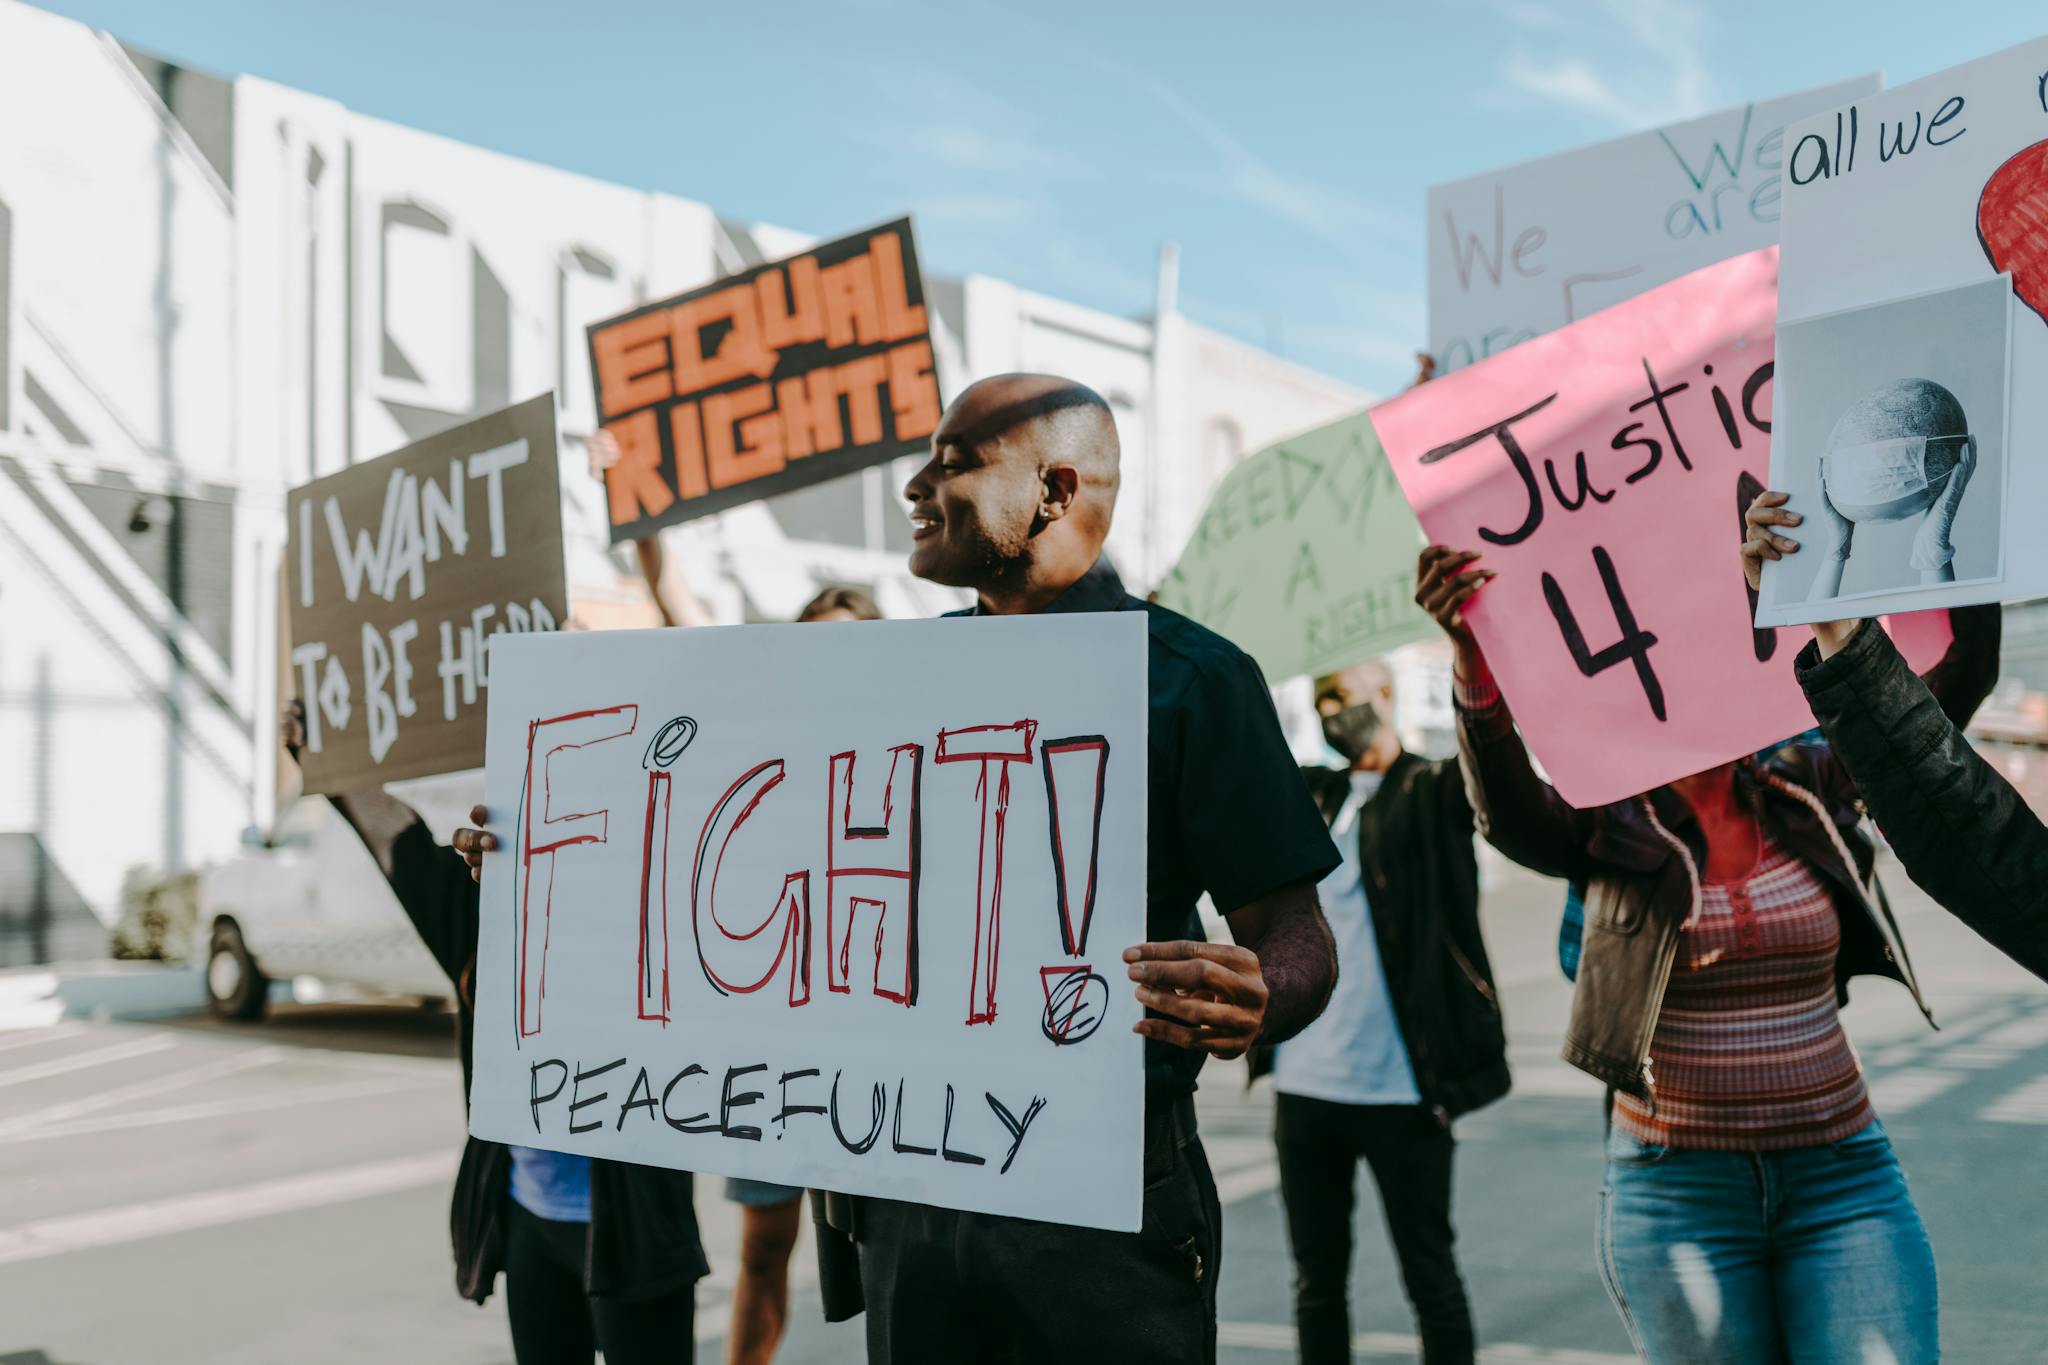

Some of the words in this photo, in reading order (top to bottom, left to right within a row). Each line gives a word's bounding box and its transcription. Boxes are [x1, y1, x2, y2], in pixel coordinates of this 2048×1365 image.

[1657, 101, 1785, 191] We
[1663, 173, 1783, 241] are
[1789, 105, 1858, 186] all
[1878, 95, 1968, 163] we
[1441, 182, 1549, 294] We
[592, 230, 929, 419] EQUAL
[599, 339, 943, 526] RIGHTS
[1417, 356, 1775, 546] Justic
[299, 498, 315, 608] I
[323, 437, 530, 603] WANT
[1304, 570, 1416, 650] RIGHT
[1540, 545, 1669, 723] 4
[360, 616, 420, 765] BE
[528, 1057, 1048, 1174] PEACEFULLY
